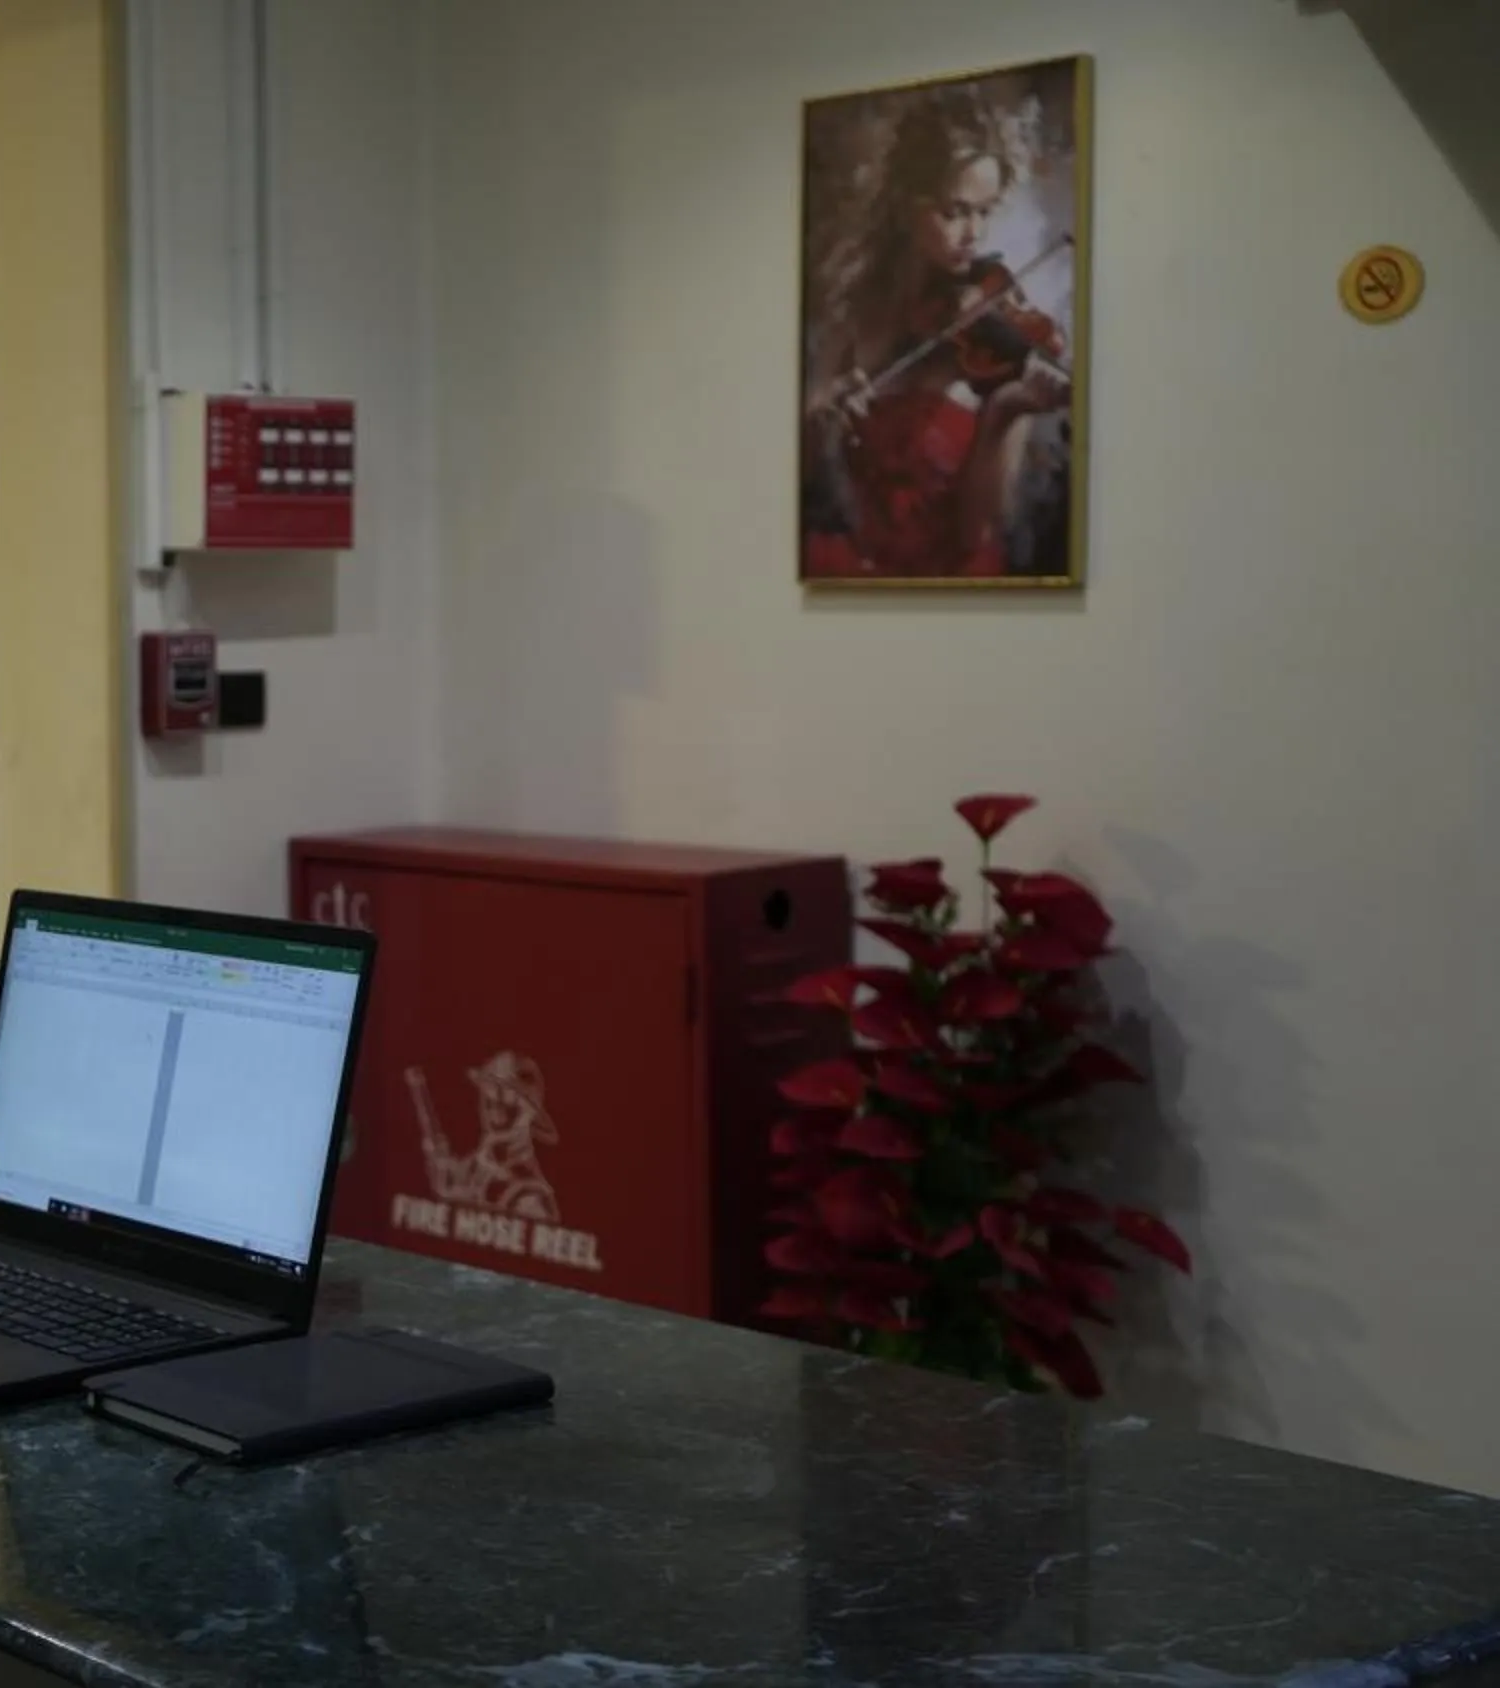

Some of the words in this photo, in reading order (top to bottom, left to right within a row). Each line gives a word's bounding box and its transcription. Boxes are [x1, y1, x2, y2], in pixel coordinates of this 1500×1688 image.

[392, 1194, 450, 1238] FIRE
[454, 1208, 527, 1255] HOSE
[531, 1223, 603, 1271] REEL
